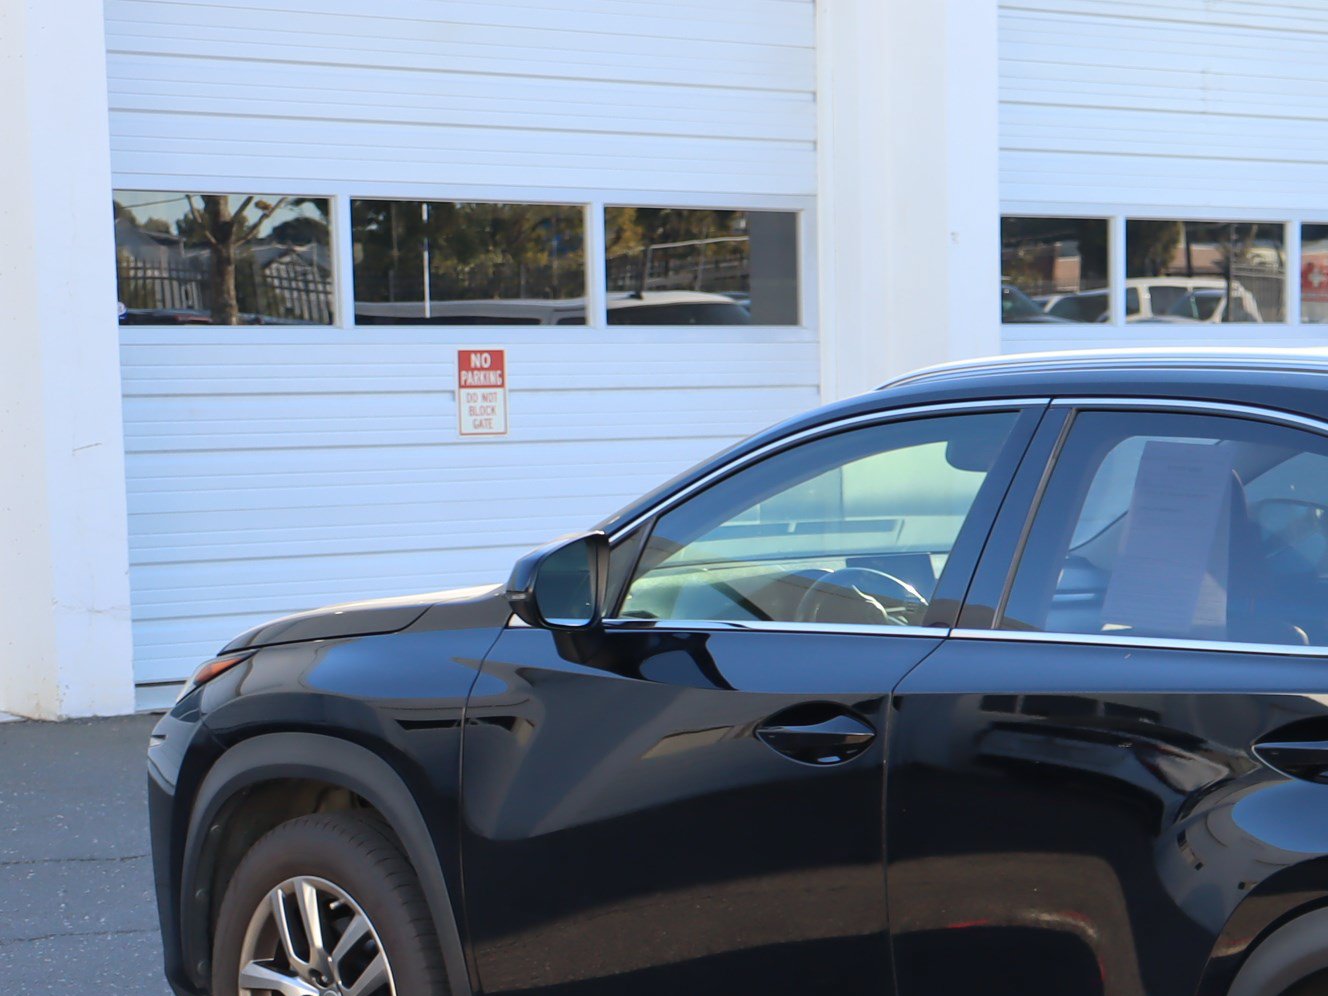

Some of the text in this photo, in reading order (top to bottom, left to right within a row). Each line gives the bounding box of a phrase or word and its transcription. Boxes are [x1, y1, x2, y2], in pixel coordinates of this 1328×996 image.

[471, 352, 491, 368] NO
[461, 370, 502, 385] PARKING
[466, 392, 498, 403] DO NOT
[469, 405, 497, 416] BLOCK
[473, 418, 493, 429] GATE
